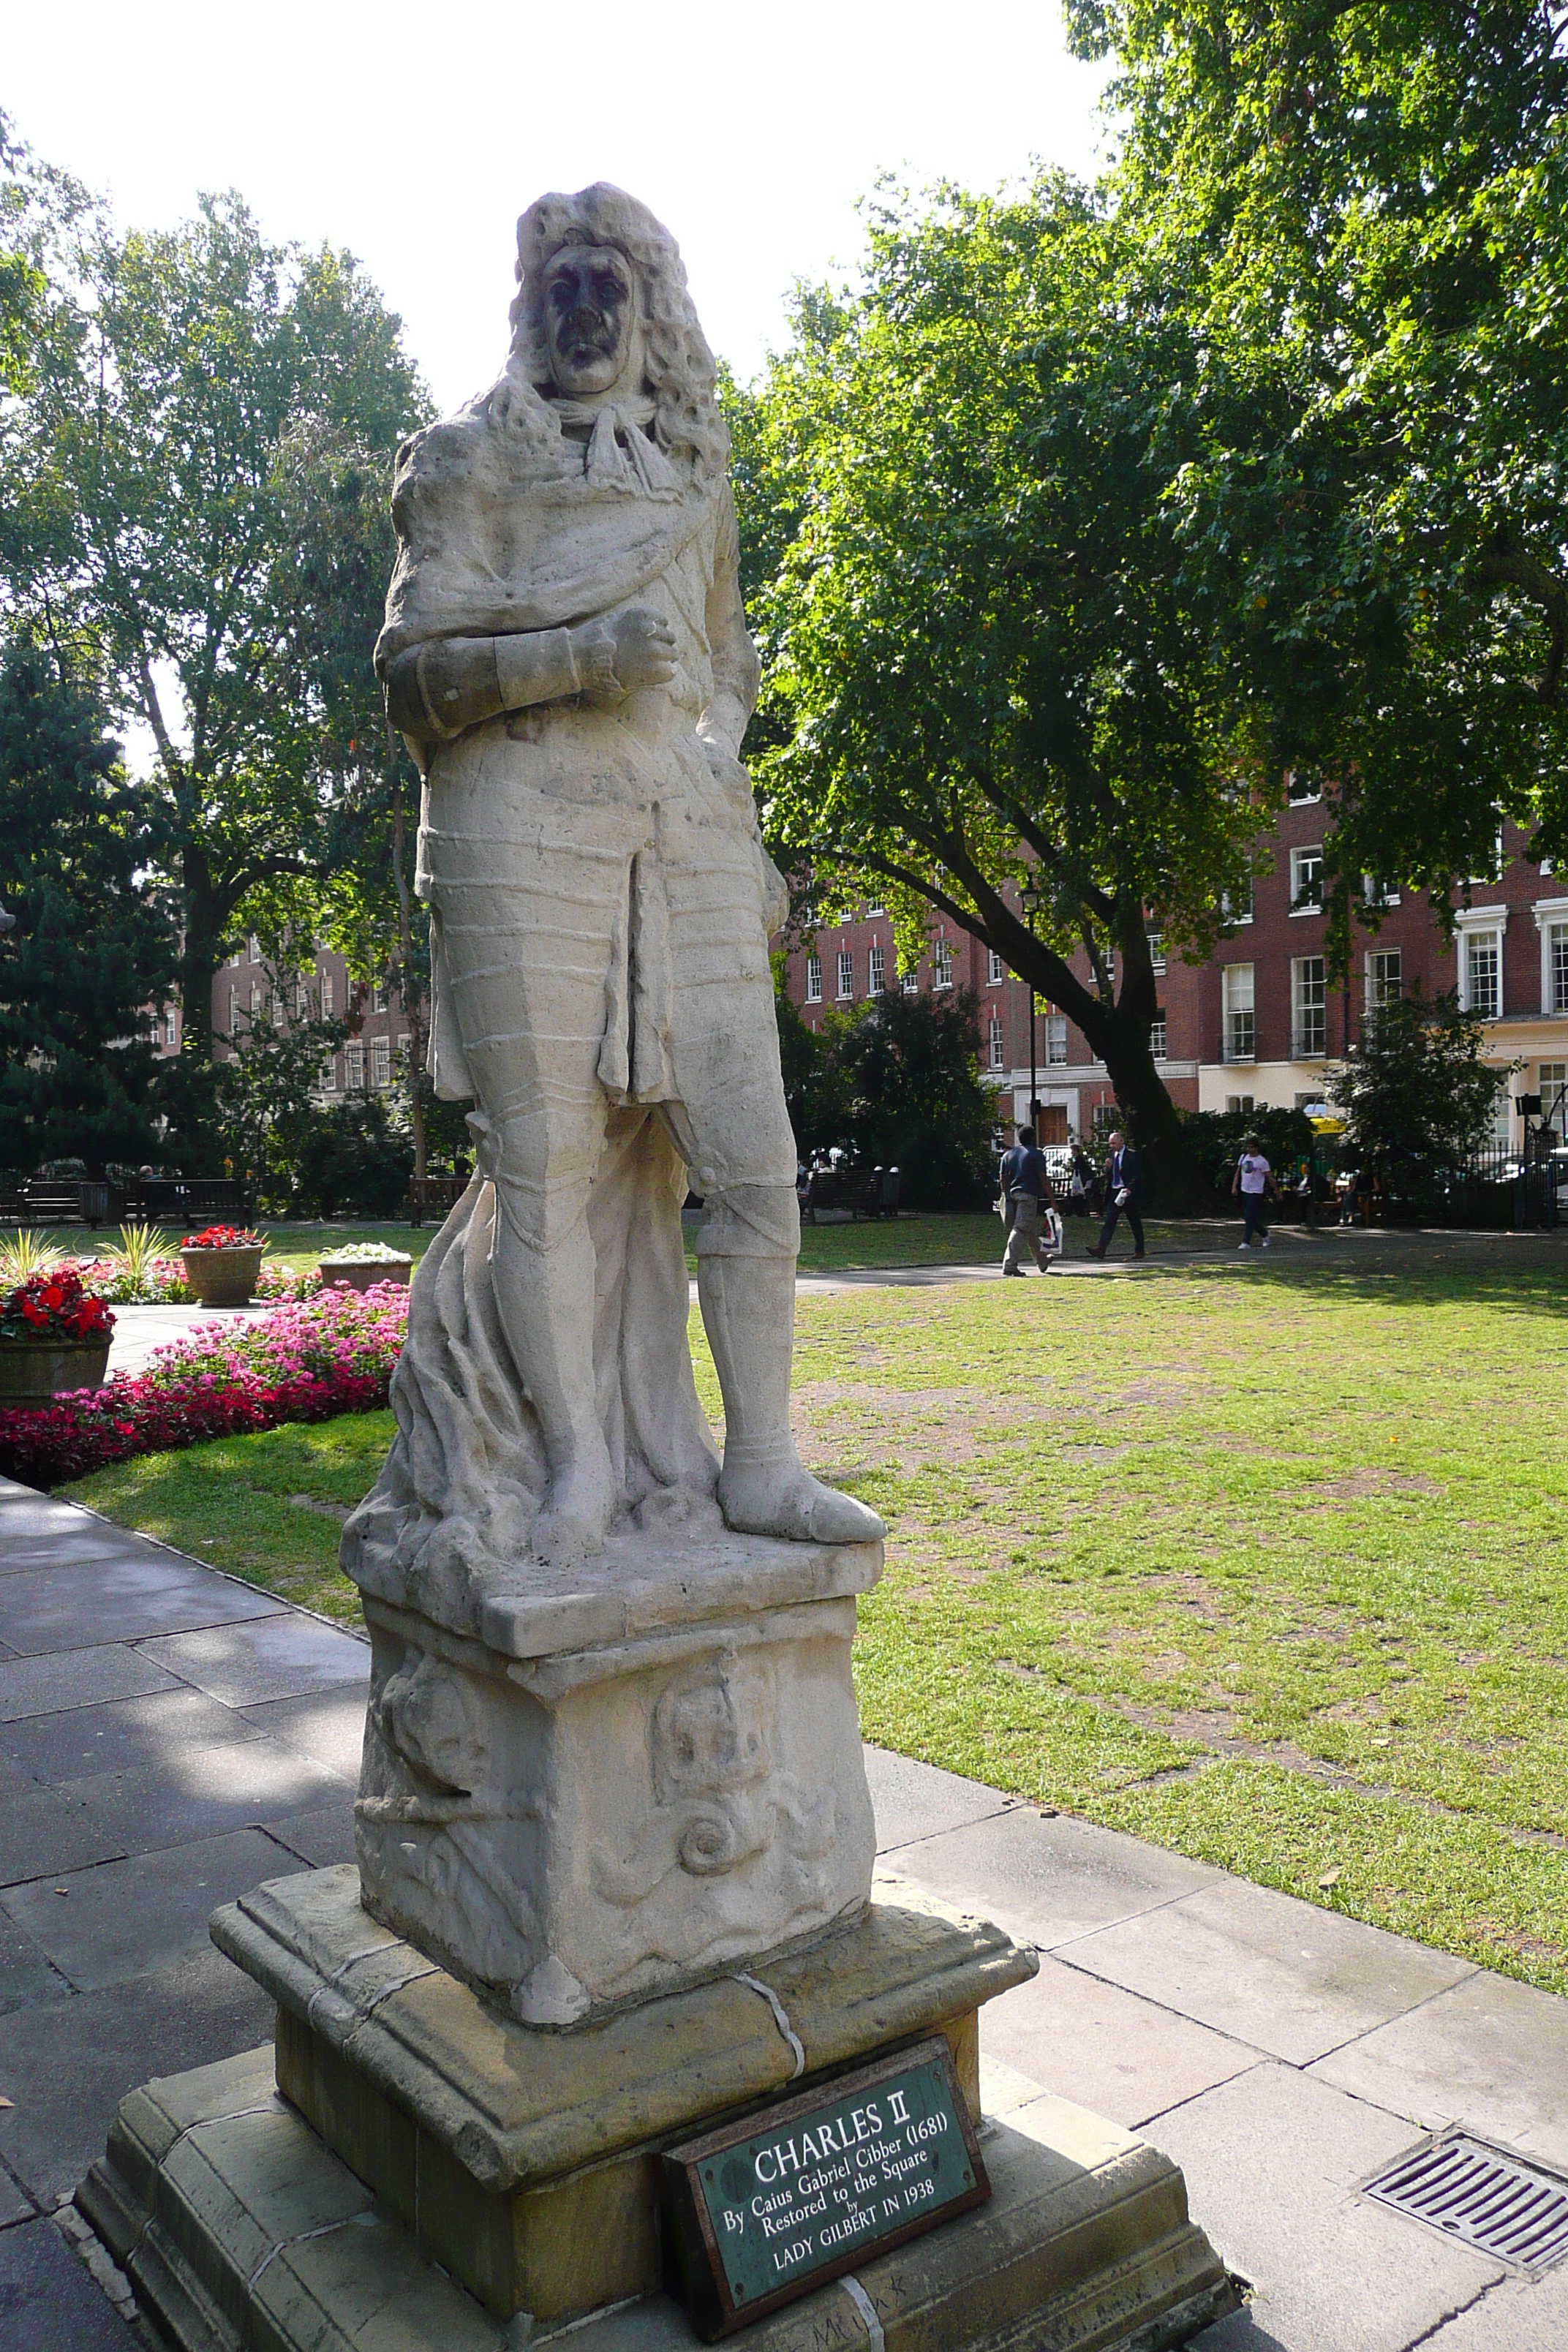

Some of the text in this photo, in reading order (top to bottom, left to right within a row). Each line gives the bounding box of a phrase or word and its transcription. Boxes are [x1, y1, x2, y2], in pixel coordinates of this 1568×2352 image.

[723, 2111, 948, 2234] By Caius Gabriel Cibber (1681)
[755, 2089, 911, 2182] CHARLES II
[761, 2150, 927, 2238] Restored to the Square
[773, 2179, 935, 2270] LADY GILBERT IN 1938
[846, 2201, 858, 2216] by
